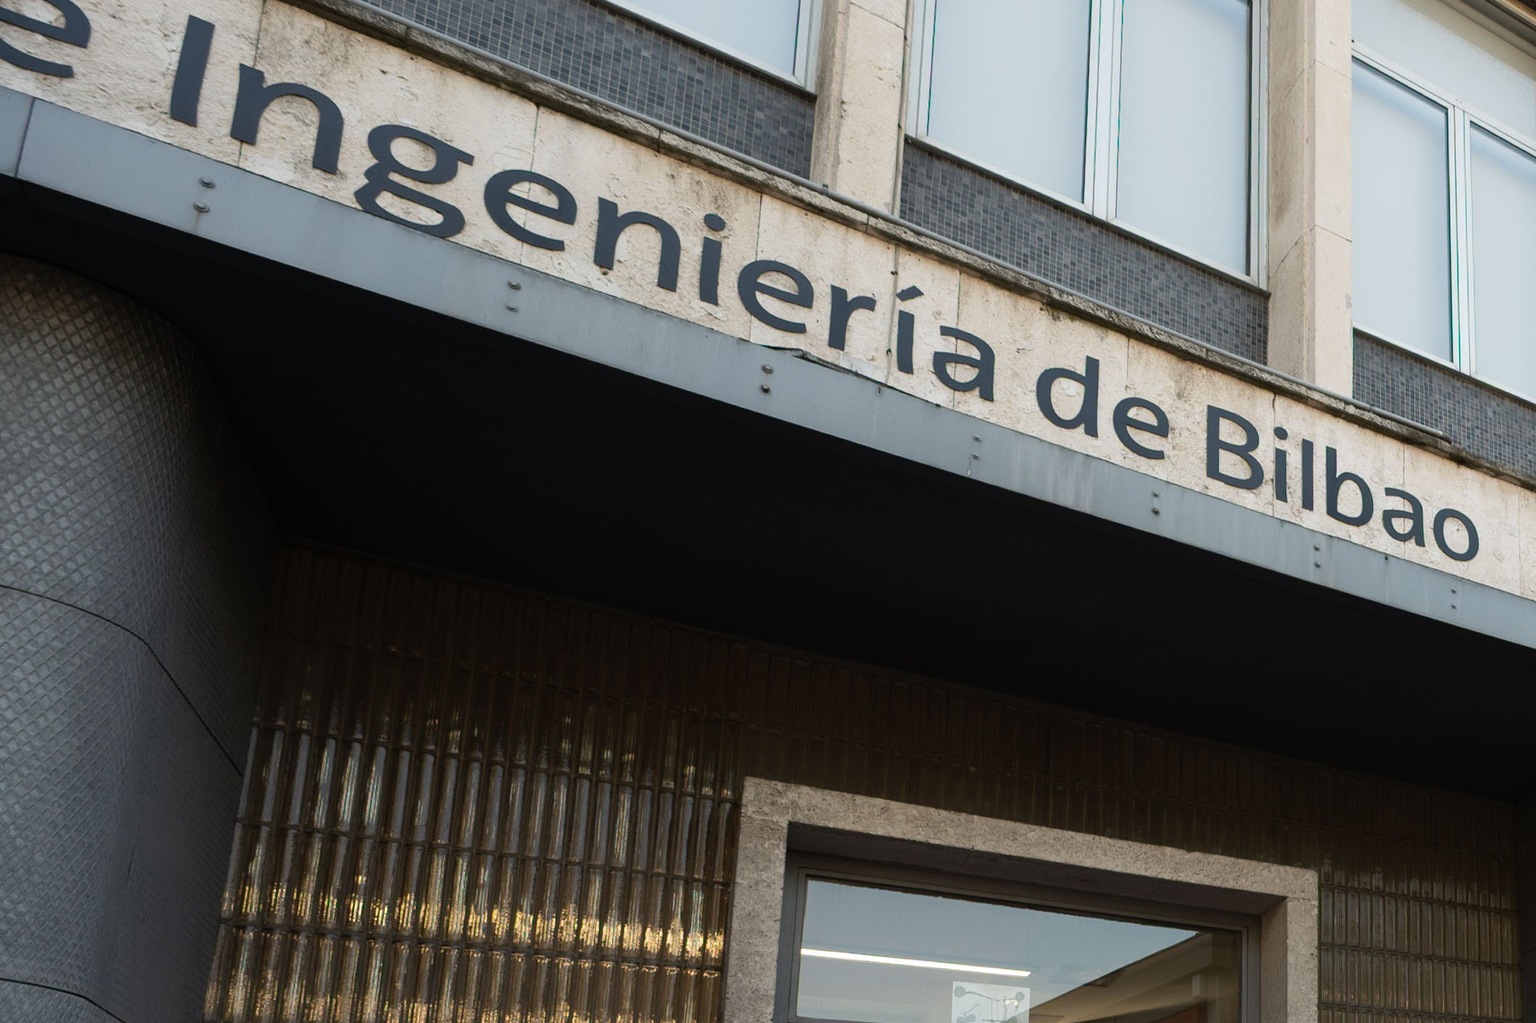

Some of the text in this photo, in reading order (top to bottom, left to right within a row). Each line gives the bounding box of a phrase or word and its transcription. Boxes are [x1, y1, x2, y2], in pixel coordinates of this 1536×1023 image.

[170, 14, 994, 401] Ingeniería
[1035, 356, 1169, 459] de
[1205, 404, 1480, 561] Bilbao
